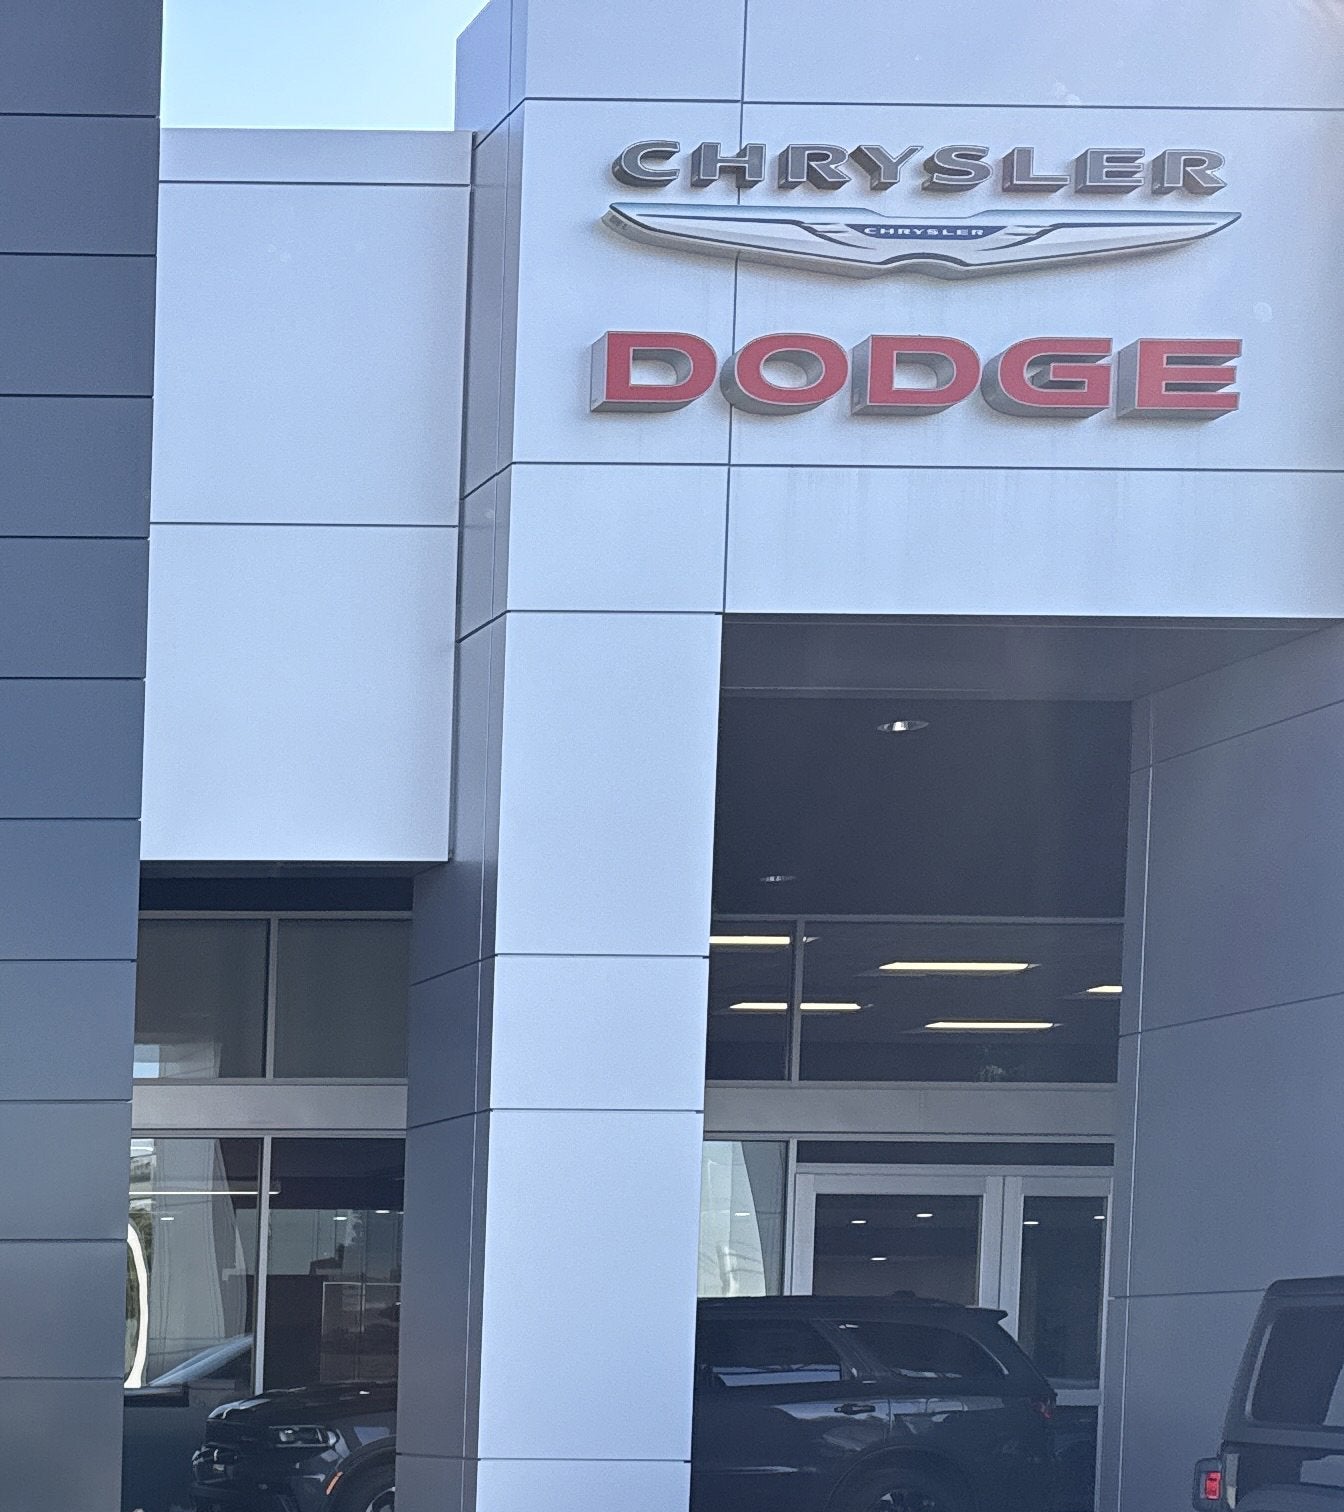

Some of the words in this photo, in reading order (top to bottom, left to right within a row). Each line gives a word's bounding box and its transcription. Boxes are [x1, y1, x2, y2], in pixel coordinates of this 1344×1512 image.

[611, 140, 1226, 195] CHRYSLER
[864, 226, 984, 237] CHRYSLER
[591, 330, 1242, 419] DODGE
